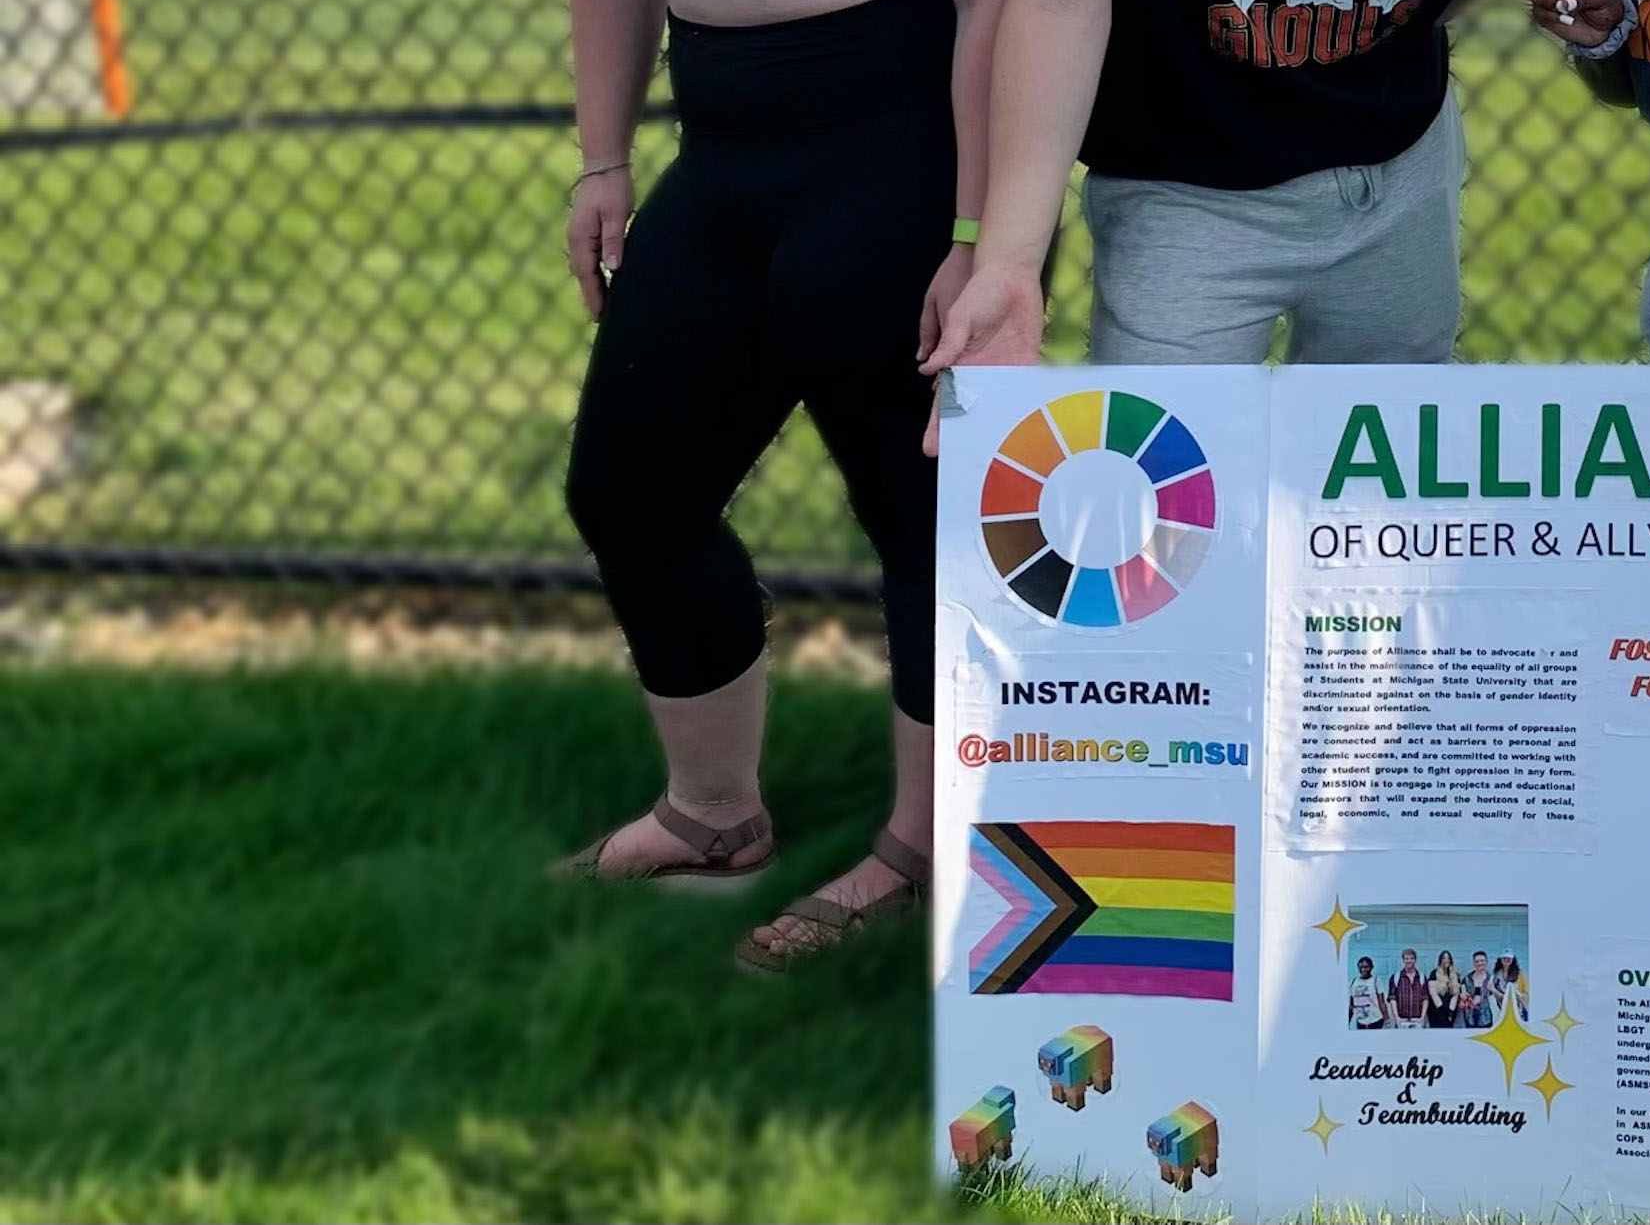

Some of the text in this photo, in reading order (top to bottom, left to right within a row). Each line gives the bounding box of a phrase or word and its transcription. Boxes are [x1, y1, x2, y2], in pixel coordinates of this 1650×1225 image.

[1309, 523, 1365, 561] OF
[1377, 522, 1517, 562] QUEER
[1530, 520, 1561, 558] &
[1305, 615, 1402, 633] MISSION
[1386, 647, 1428, 655] Alliance
[1471, 663, 1511, 672] equality
[1389, 676, 1435, 686] Michigan
[1476, 677, 1527, 687] University
[1000, 680, 1212, 706] INSTAGRAM:
[1303, 690, 1372, 698] discriminated
[1376, 691, 1414, 700] against
[1455, 691, 1481, 699] basis
[1499, 692, 1534, 701] gender
[1538, 692, 1577, 702] identity
[1373, 704, 1432, 712] orientation.
[1321, 724, 1370, 732] recognize
[1521, 725, 1577, 733] oppression
[957, 733, 1249, 770] @alliance_msu
[1617, 1026, 1645, 1034] LBGT
[1308, 1056, 1444, 1087] Leadership
[1396, 1082, 1418, 1105] &
[1358, 1101, 1528, 1134] Teambuilding
